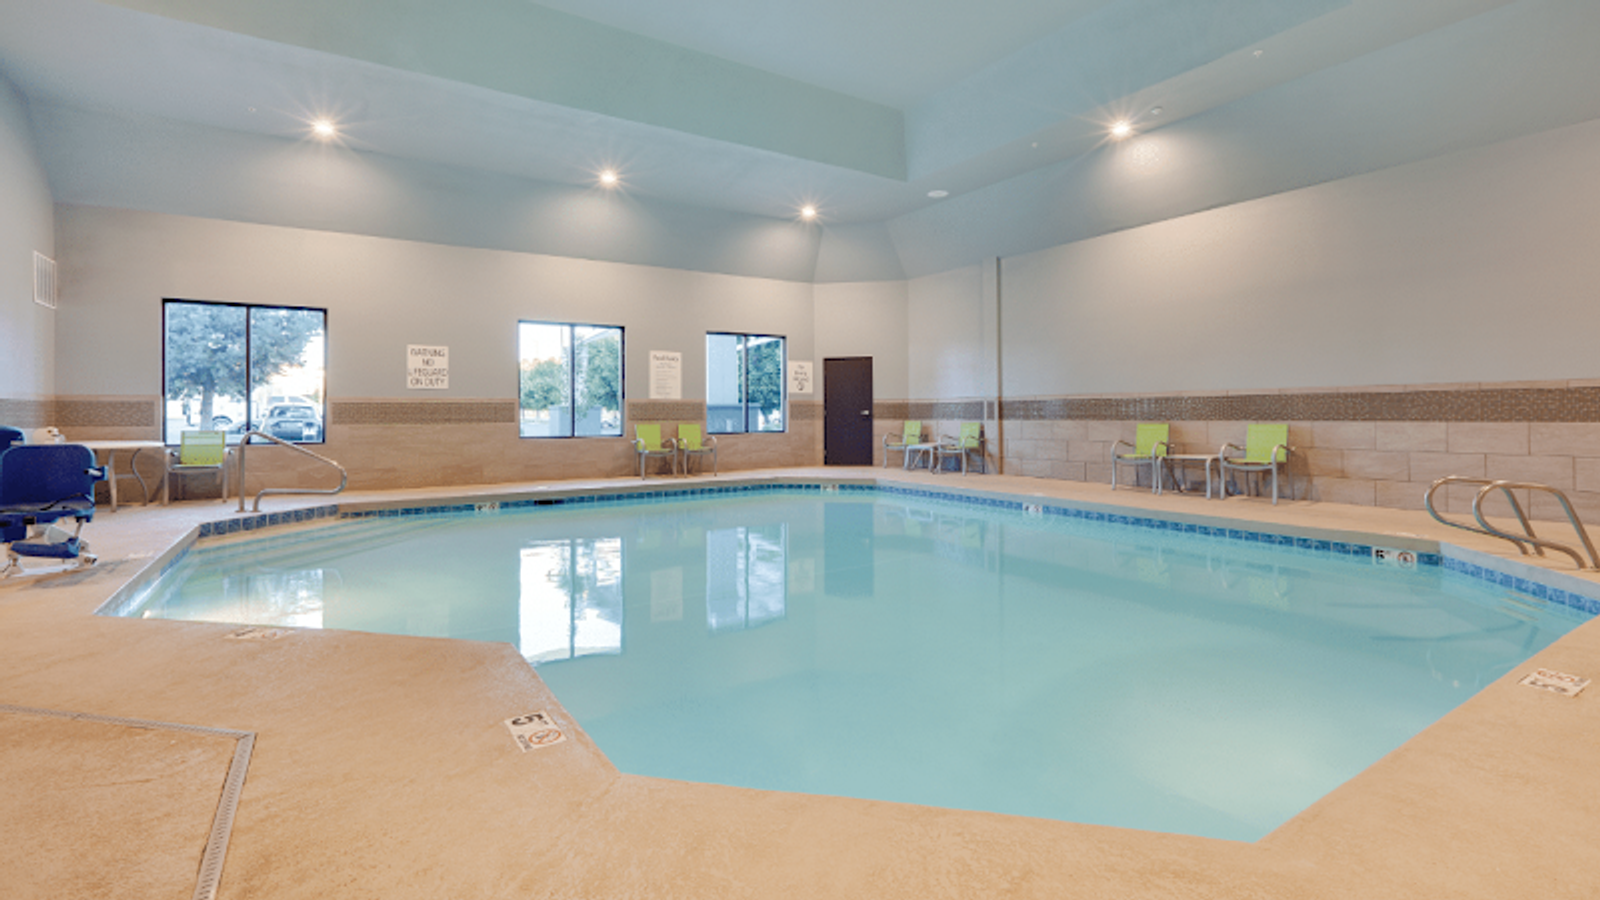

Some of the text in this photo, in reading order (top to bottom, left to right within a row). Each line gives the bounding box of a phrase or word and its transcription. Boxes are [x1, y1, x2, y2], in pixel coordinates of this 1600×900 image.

[422, 358, 435, 367] NO
[410, 377, 446, 387] ON DUTY
[511, 712, 543, 727] 5
